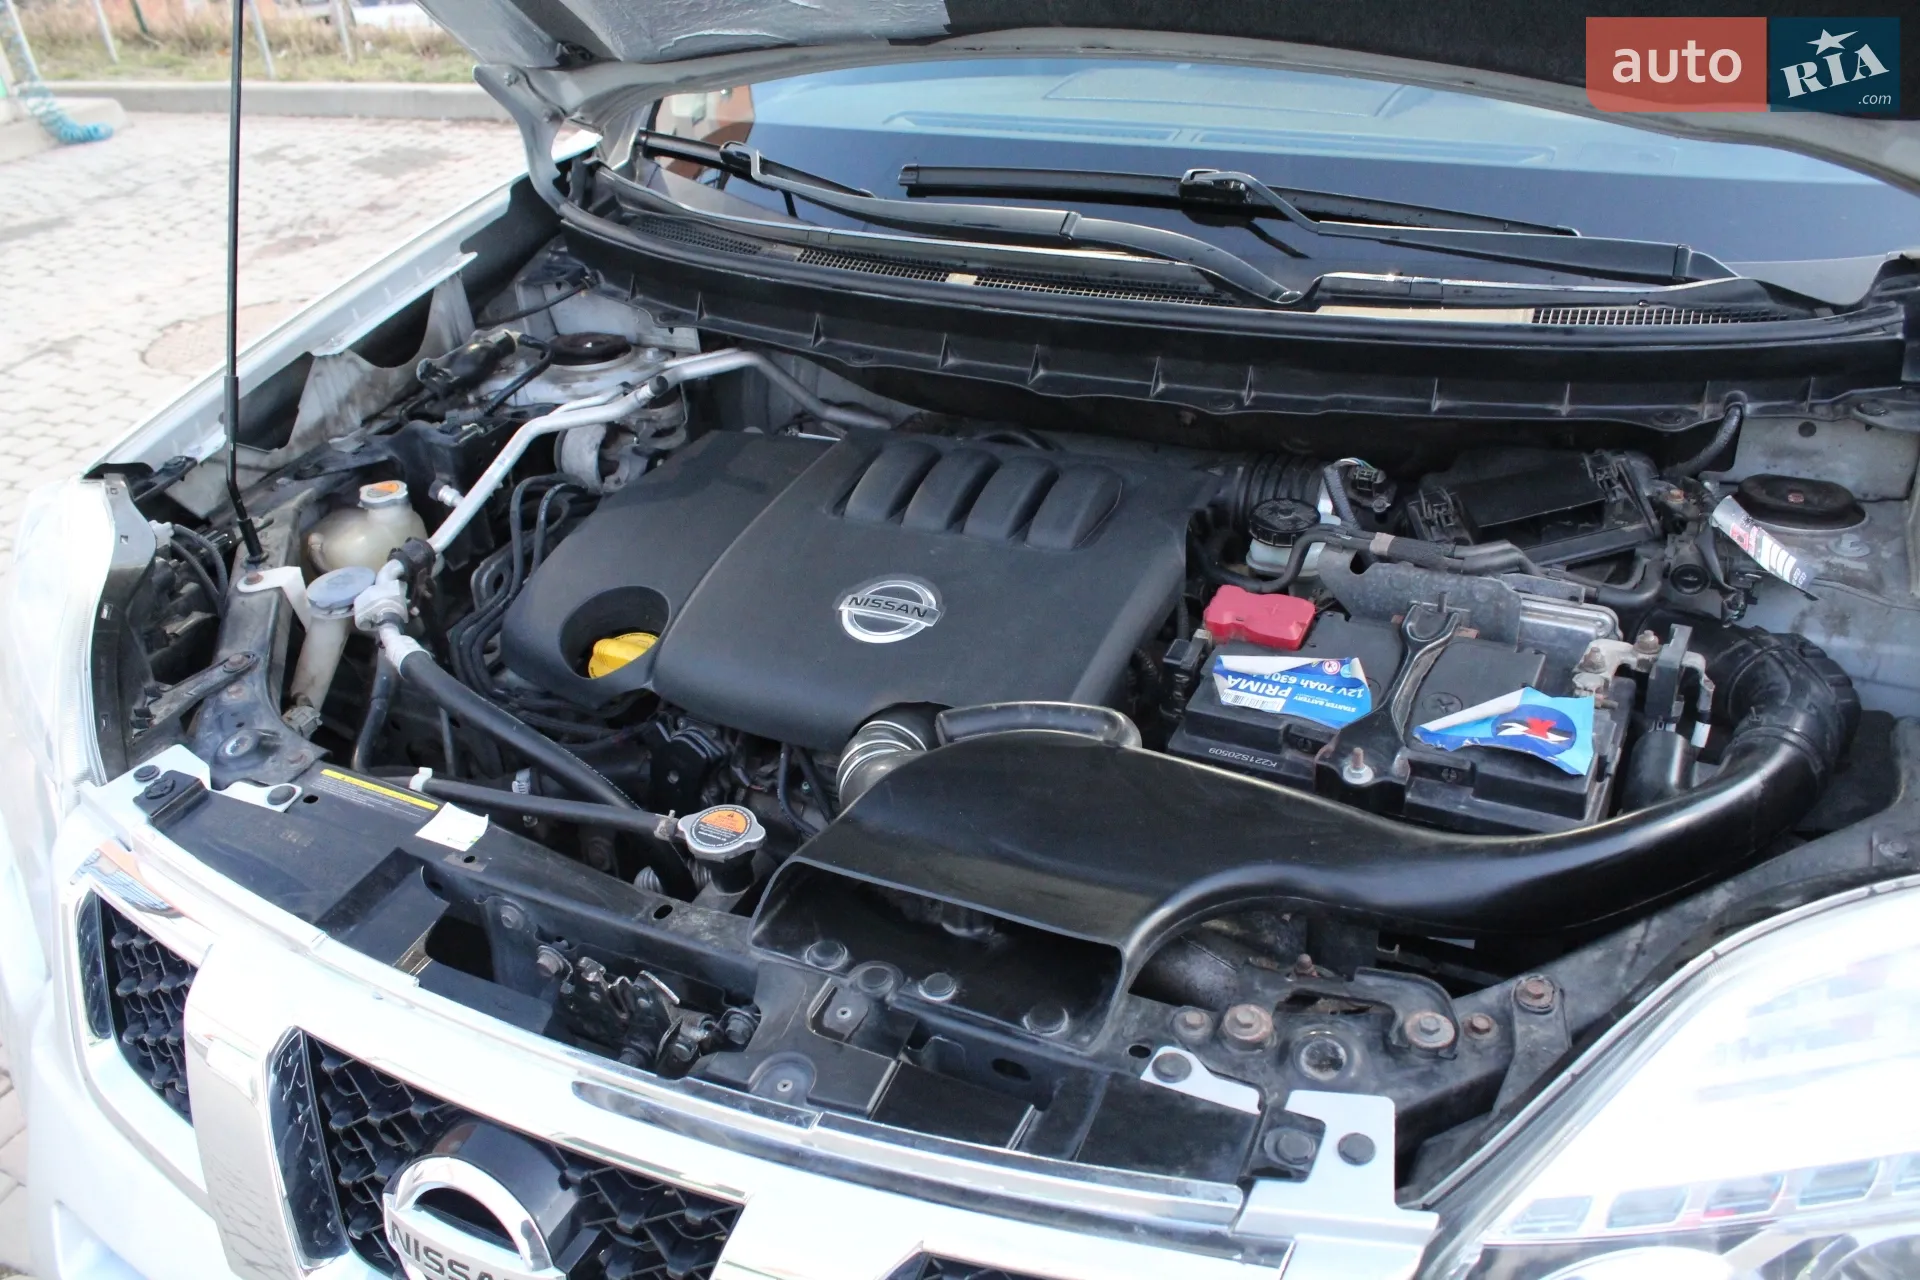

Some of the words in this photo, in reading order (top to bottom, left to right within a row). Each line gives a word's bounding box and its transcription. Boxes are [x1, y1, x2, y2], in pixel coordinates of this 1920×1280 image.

[848, 596, 929, 618] NISSAN
[1227, 675, 1293, 698] PRIMA
[1300, 678, 1335, 694] 70Ah
[1337, 687, 1365, 699] 12V
[1293, 695, 1326, 707] BATTERY
[1325, 700, 1357, 713] STARTER
[1208, 747, 1278, 768] K221S20509
[391, 1219, 514, 1280] NISS
